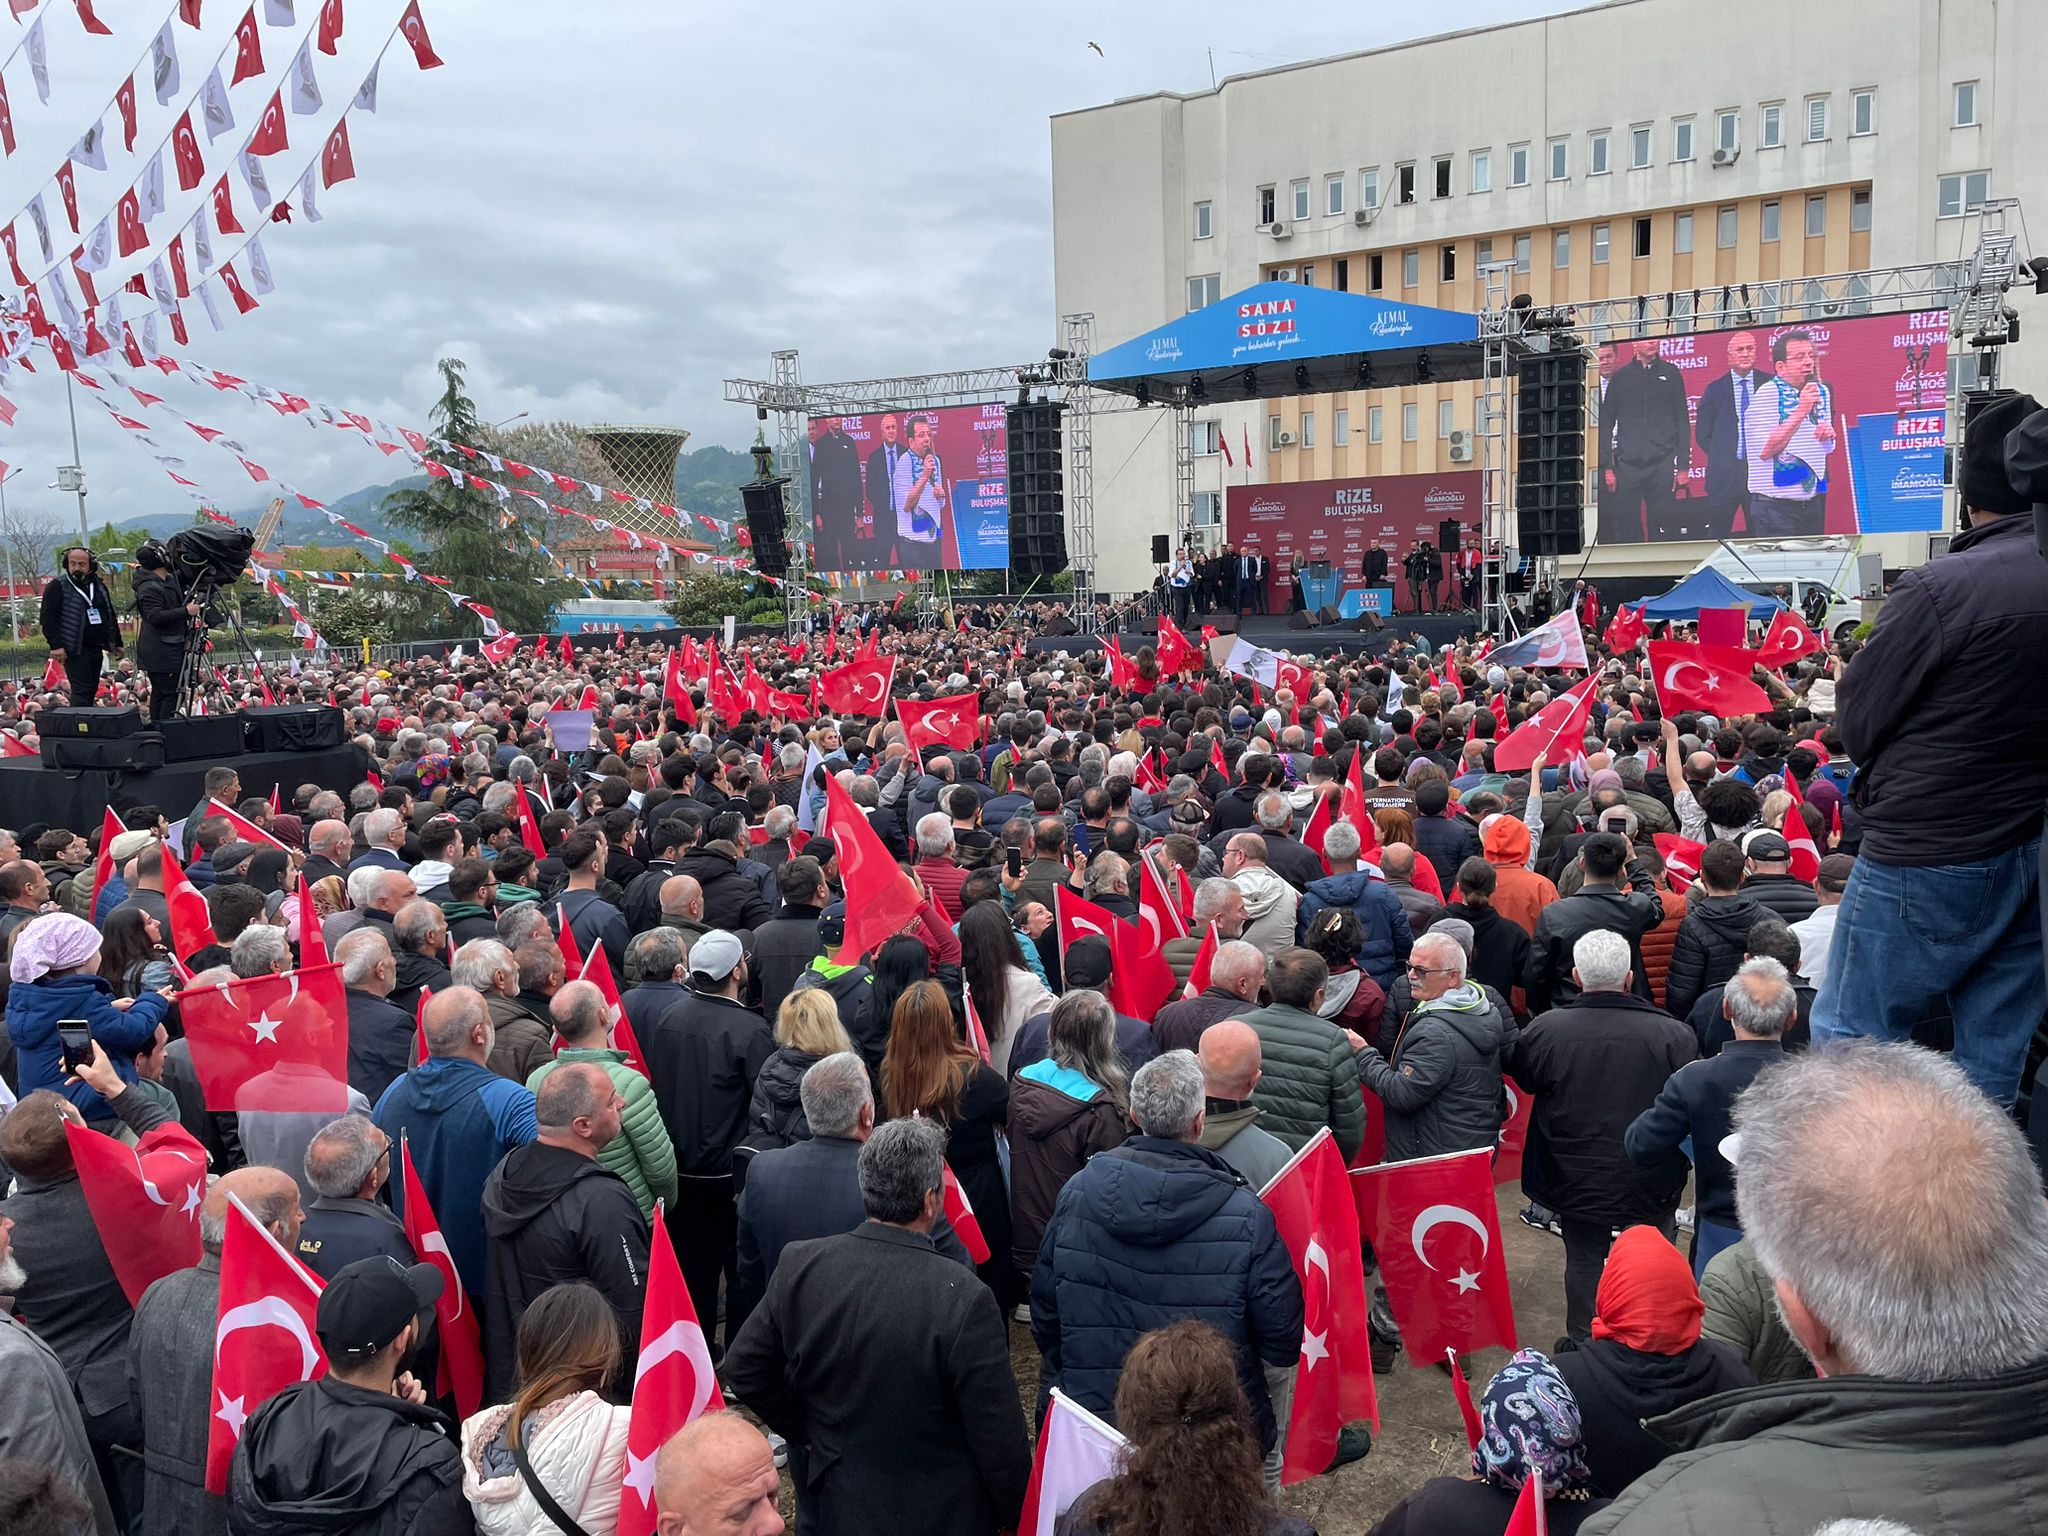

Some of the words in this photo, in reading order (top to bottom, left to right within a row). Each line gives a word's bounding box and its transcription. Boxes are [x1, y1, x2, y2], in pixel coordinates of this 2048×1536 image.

[1241, 299, 1292, 318] SANA
[1377, 309, 1406, 324] KEMAL
[1241, 319, 1292, 338] SÖZ!
[1324, 503, 1383, 517] BULUŞMASI
[582, 622, 619, 634] SANA
[622, 1244, 636, 1273] COMFORT
